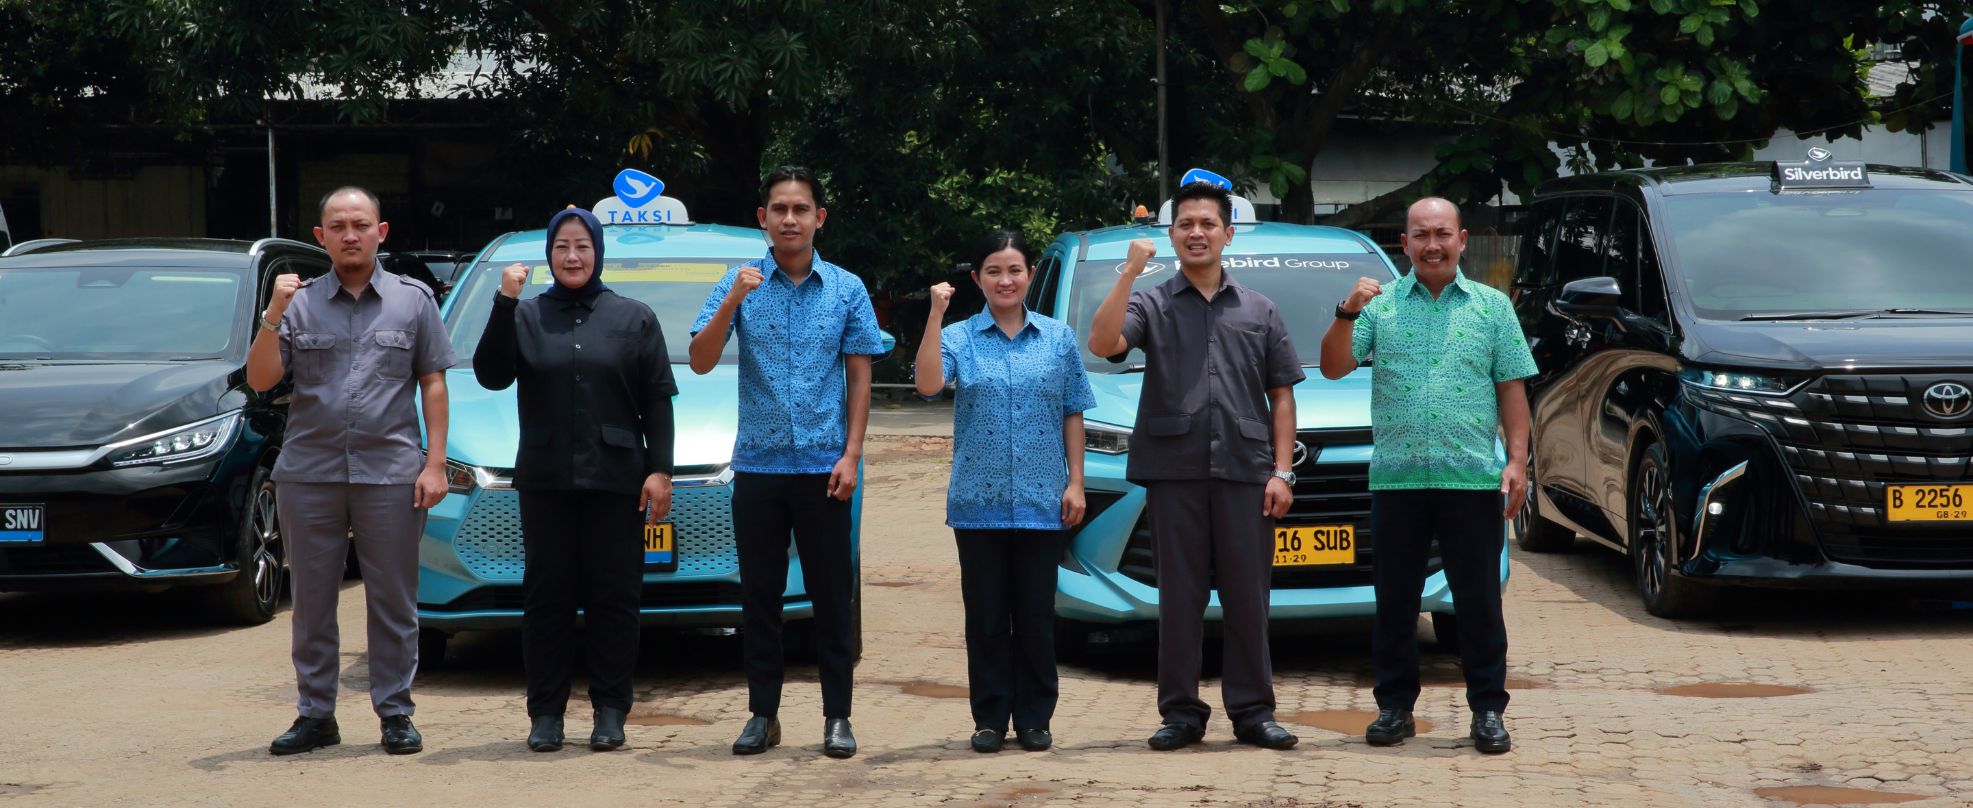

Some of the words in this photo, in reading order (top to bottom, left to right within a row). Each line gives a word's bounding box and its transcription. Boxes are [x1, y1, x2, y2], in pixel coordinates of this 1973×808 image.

[1784, 167, 1863, 181] Silverbird
[608, 209, 671, 223] TAKSI
[1284, 258, 1350, 270] Group
[1892, 488, 1904, 509] B
[1915, 488, 1963, 509] 2256
[4, 509, 40, 529] SNV
[1277, 530, 1302, 552] 16
[1313, 529, 1351, 551] SUB
